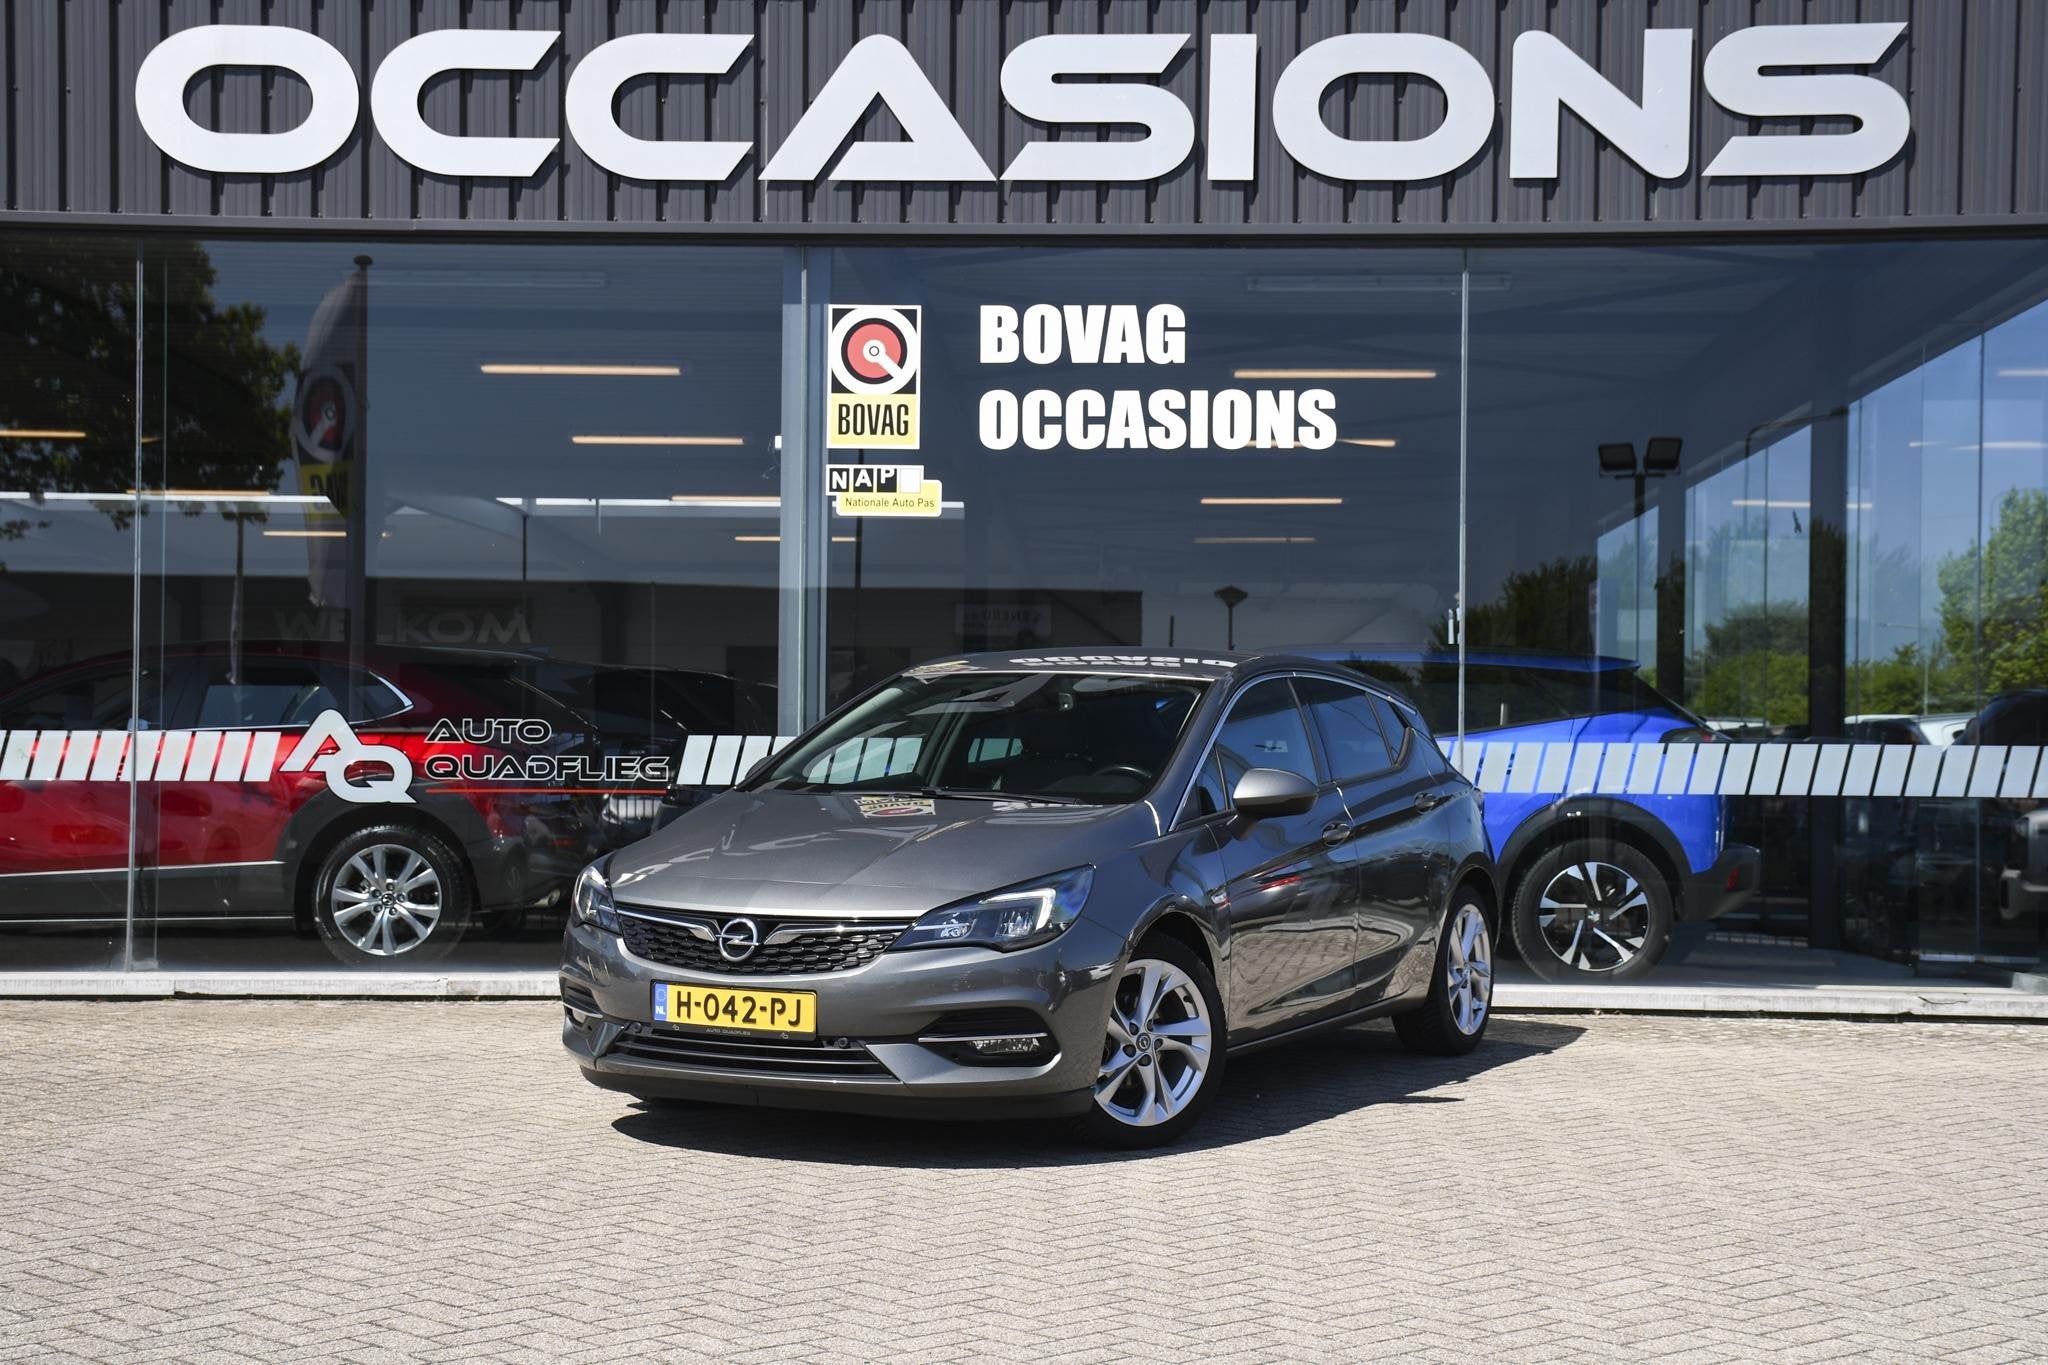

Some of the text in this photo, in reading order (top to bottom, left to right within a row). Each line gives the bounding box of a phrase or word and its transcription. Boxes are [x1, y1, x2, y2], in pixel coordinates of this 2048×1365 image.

[135, 22, 1912, 181] OCCASIONS
[979, 303, 1186, 365] BOVAG
[837, 403, 909, 436] BOVAG
[979, 388, 1338, 450] OCCASIONS
[830, 468, 896, 490] NAP
[845, 498, 935, 508] Nationale Auto Pas
[424, 717, 552, 744] AUTO
[424, 754, 670, 782] QUADFLIEG
[655, 1006, 666, 1016] NL
[676, 990, 802, 1027] H-042-PJ
